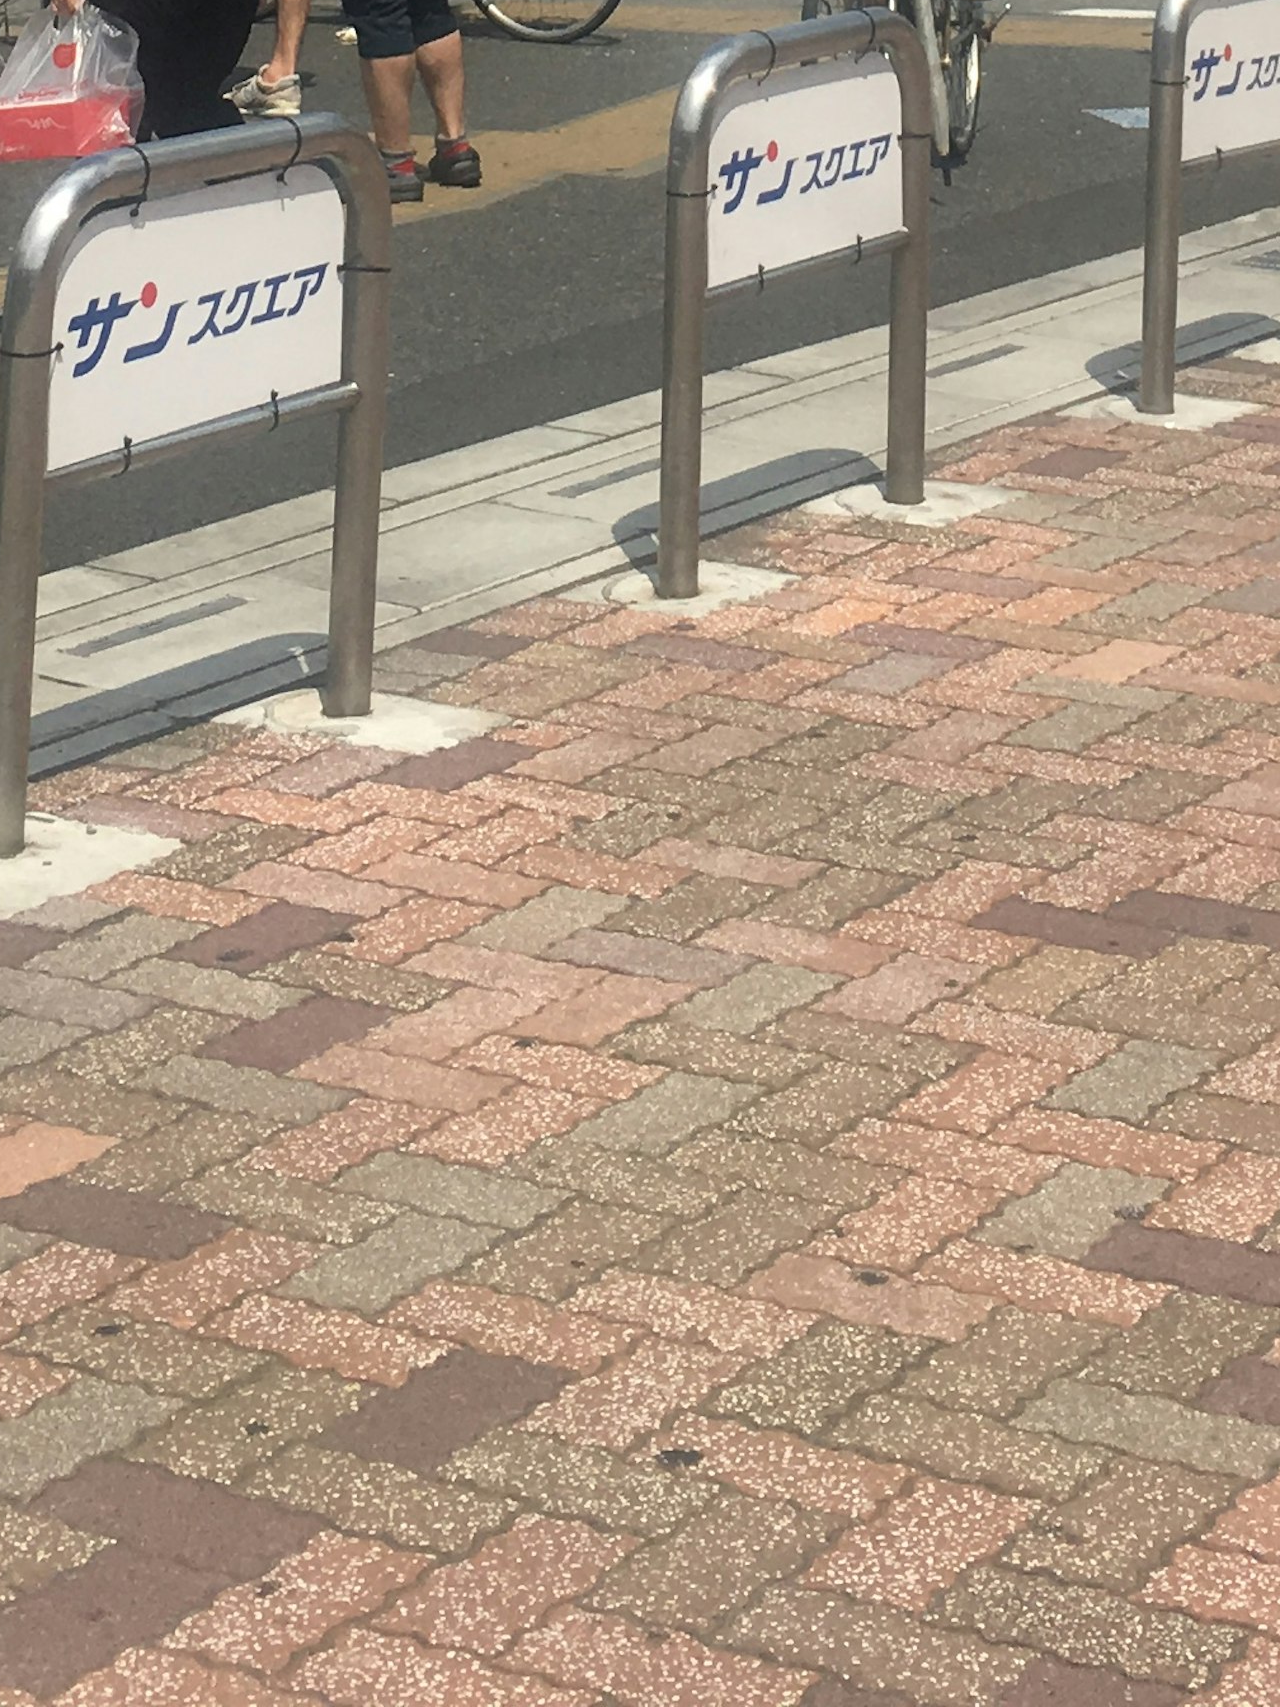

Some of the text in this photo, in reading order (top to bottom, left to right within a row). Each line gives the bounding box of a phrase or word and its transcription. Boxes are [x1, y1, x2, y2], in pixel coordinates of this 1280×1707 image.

[719, 132, 893, 215] サンスクエア
[68, 261, 330, 379] サンスクエア
